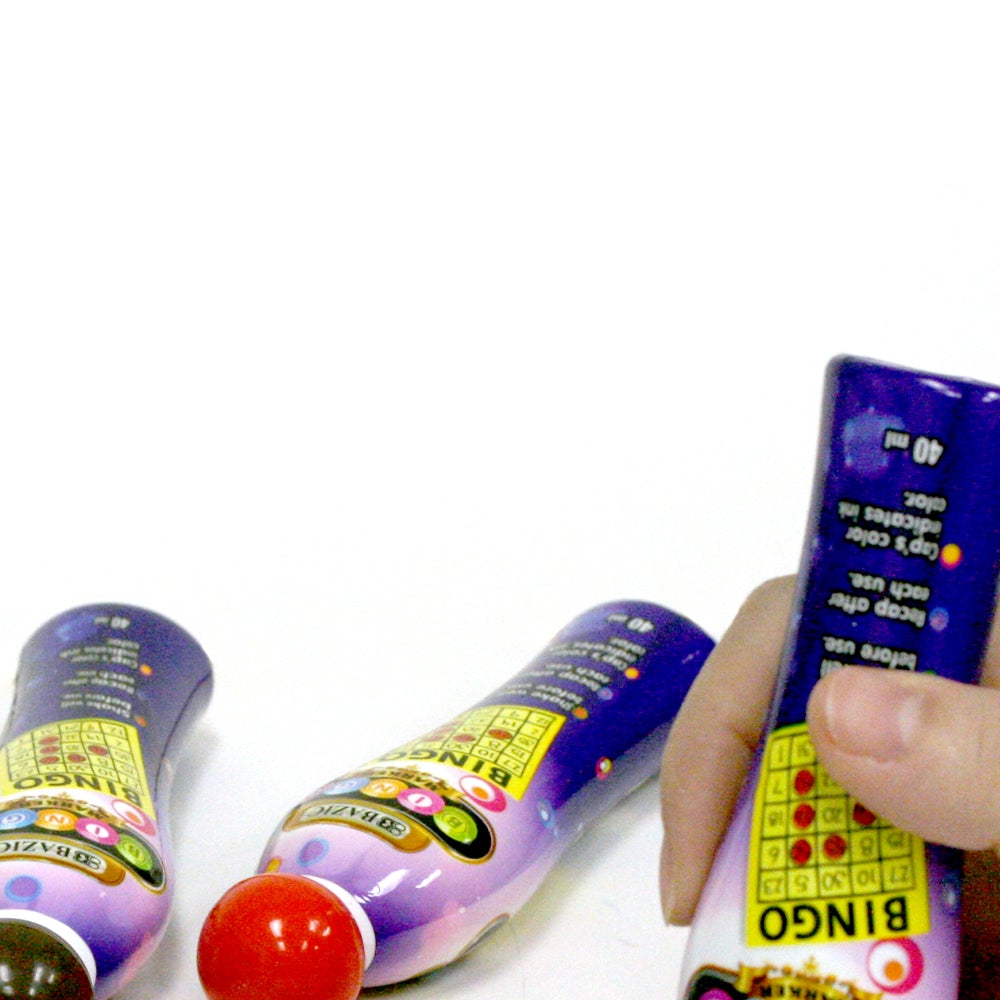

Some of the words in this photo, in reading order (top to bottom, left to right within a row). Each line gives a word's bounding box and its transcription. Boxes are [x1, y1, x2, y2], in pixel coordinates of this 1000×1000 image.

[884, 430, 910, 449] ml
[913, 435, 944, 466] 40
[845, 526, 891, 547] color
[14, 774, 142, 807] BINGO
[772, 780, 783, 795] 7
[306, 805, 376, 824] BAZIC
[768, 846, 779, 862] 6
[794, 875, 809, 892] 5
[821, 872, 845, 892] 30
[857, 871, 875, 885] 10
[759, 897, 909, 940] BINGO
